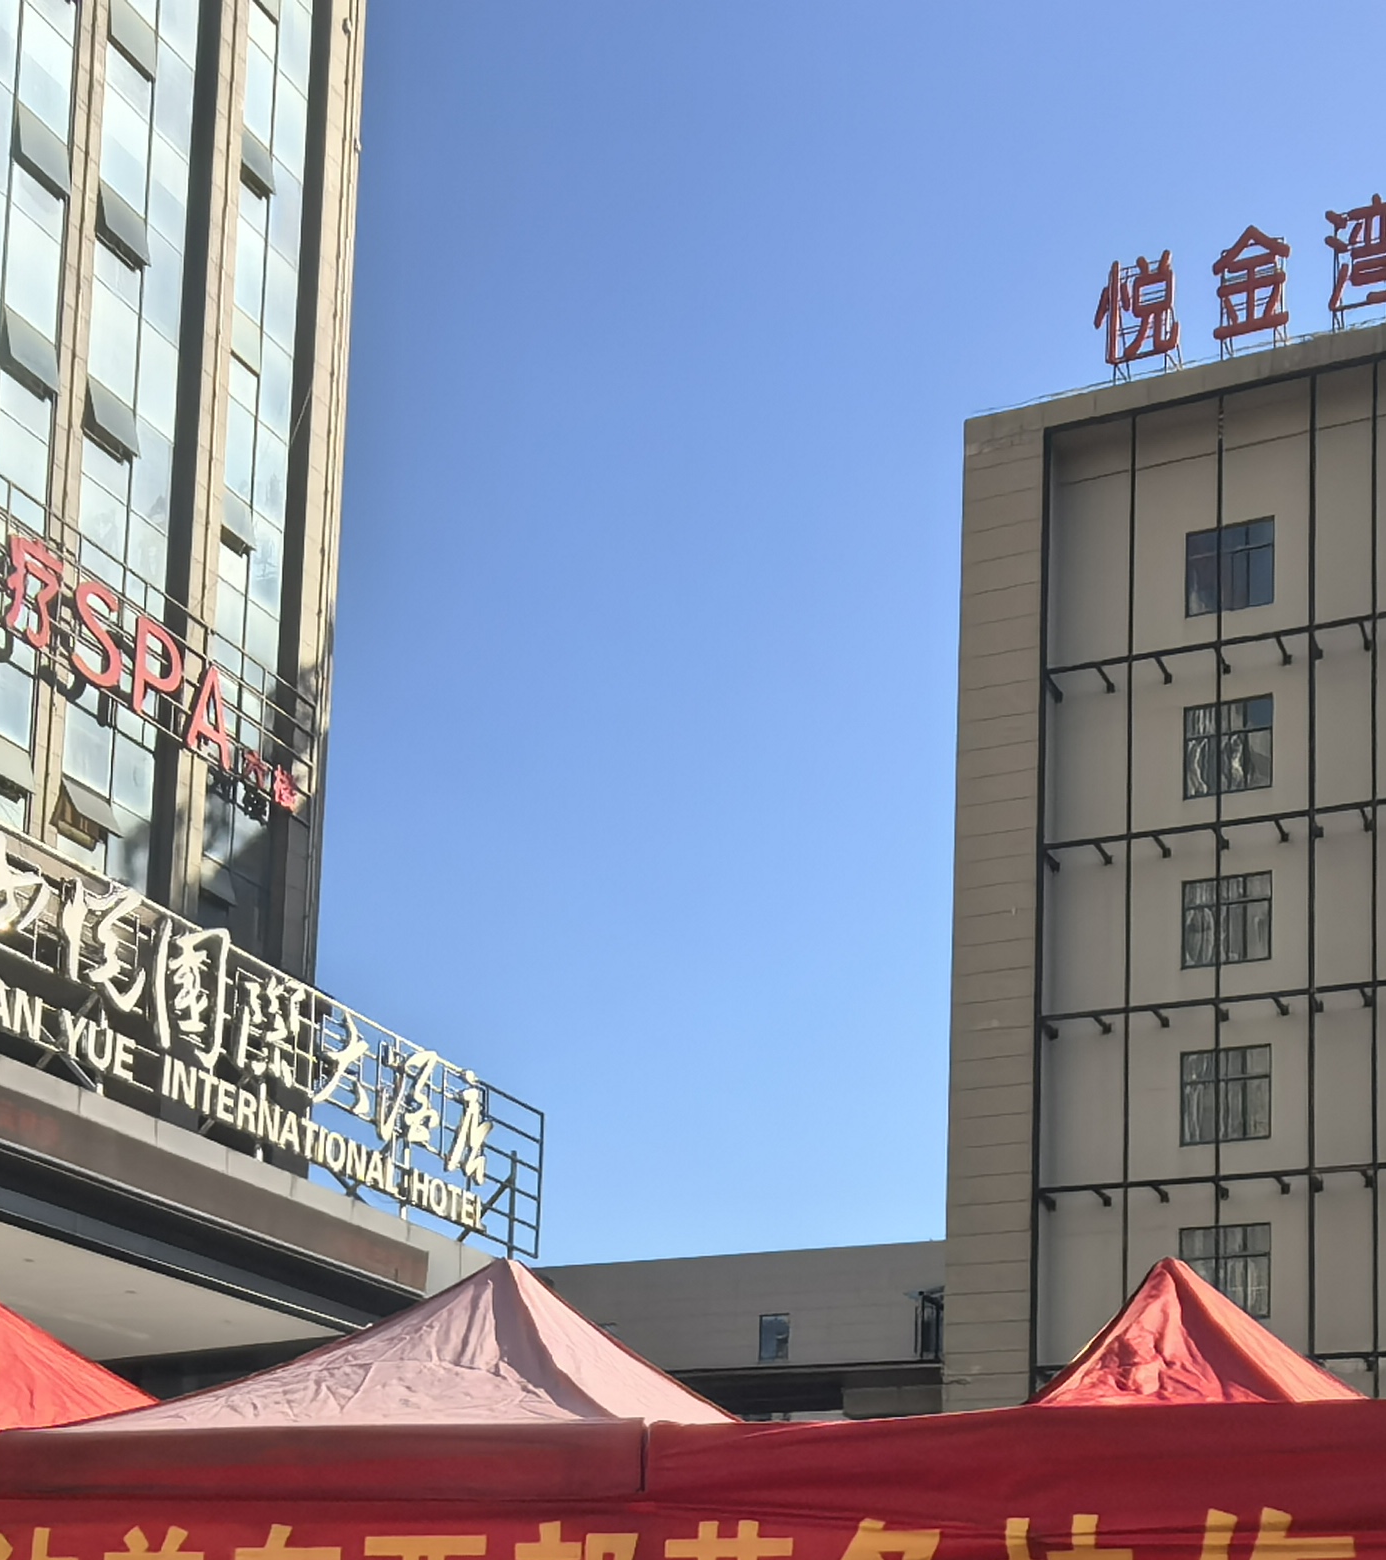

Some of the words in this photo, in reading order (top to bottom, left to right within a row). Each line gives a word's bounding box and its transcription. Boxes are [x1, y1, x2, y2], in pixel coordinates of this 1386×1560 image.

[61, 1008, 137, 1080] YUE
[161, 1055, 407, 1199] INTERNATIONAL
[413, 1171, 487, 1232] HOTEL
